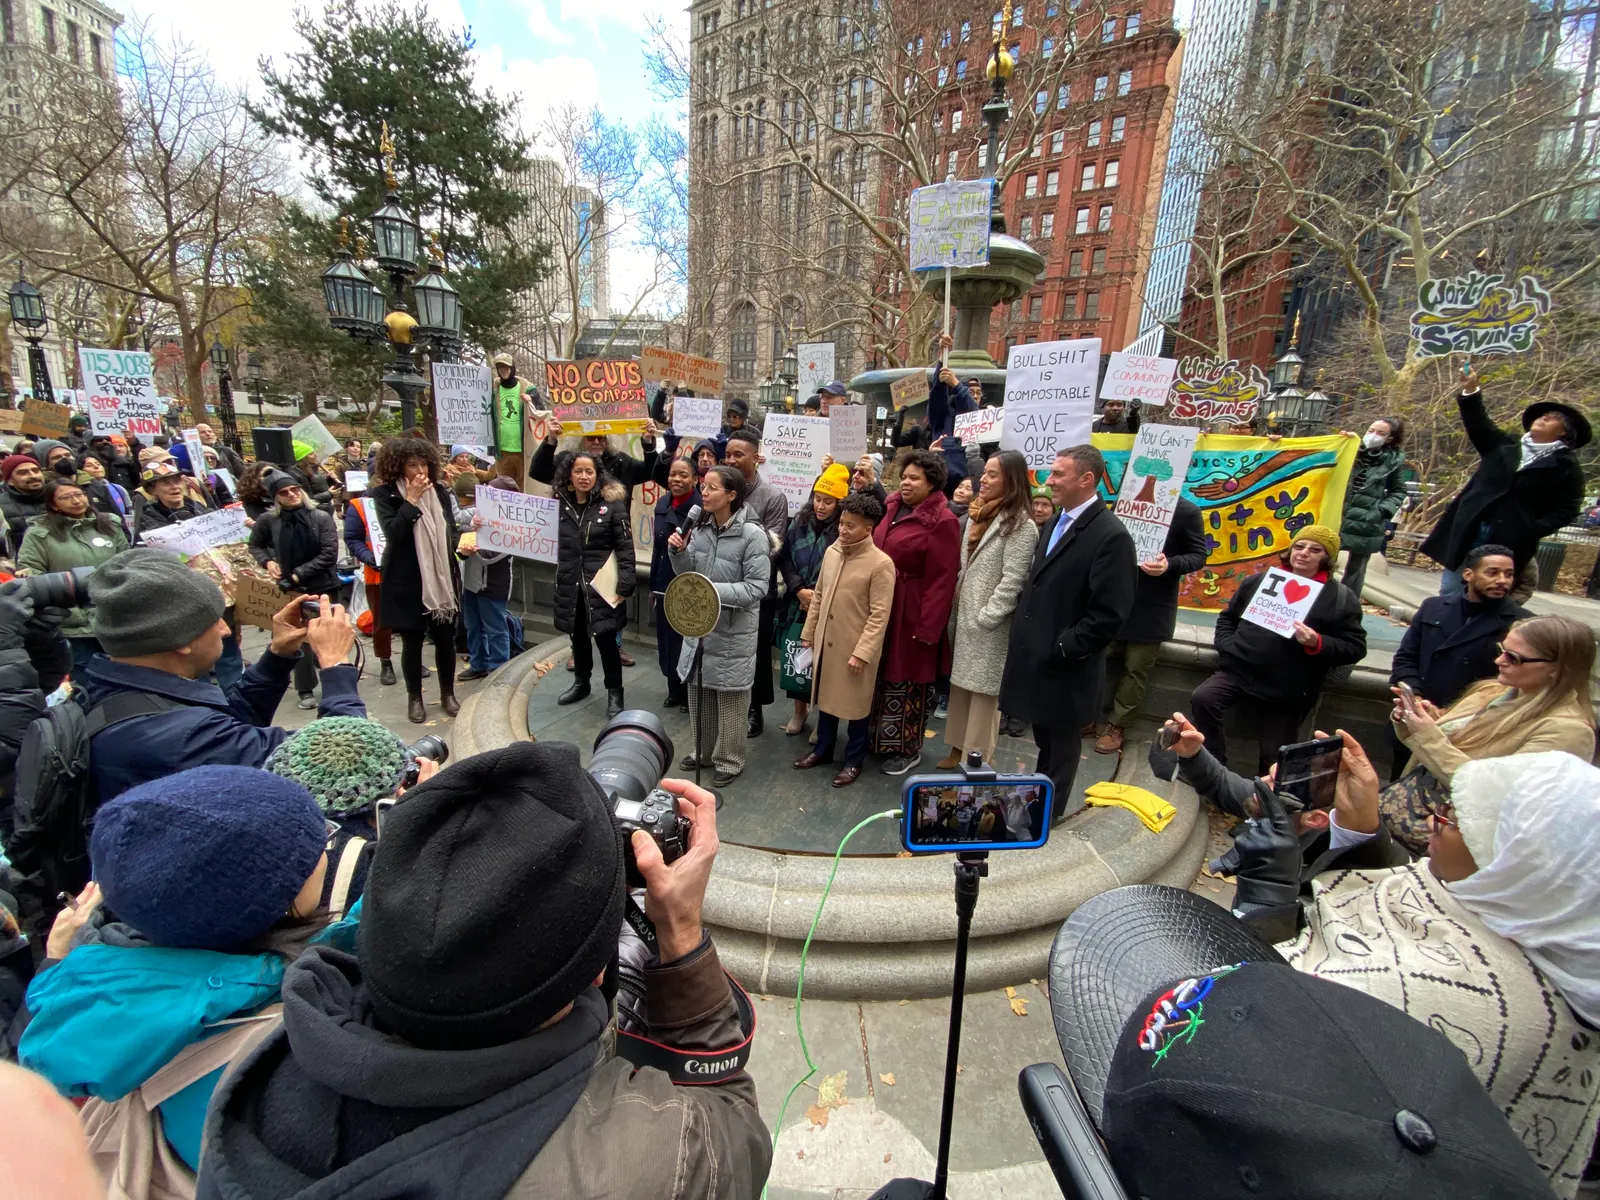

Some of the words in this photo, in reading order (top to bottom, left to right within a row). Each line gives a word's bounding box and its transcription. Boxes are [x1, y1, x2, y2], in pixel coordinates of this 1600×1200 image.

[82, 352, 112, 374] 115
[112, 353, 151, 376] JOBS
[644, 347, 686, 362] COMMUNITY
[686, 357, 718, 372] COMPOST
[1013, 349, 1089, 369] BULLSHIT
[1125, 356, 1159, 372] SAVE
[546, 363, 582, 389] NO
[586, 361, 642, 389] CUTS
[669, 360, 699, 375] BUILDING
[95, 374, 150, 387] DECADES
[648, 366, 654, 375] A
[660, 367, 686, 380] BETTER
[689, 374, 720, 390] FUTURE
[1040, 371, 1053, 382] IS
[1113, 370, 1170, 384] COMMUNITY
[113, 386, 146, 397] WORK
[550, 387, 578, 404] TO
[579, 386, 646, 404] COMPOST!
[1007, 386, 1090, 402] COMPOSTABLE
[1114, 385, 1167, 398] COMPOST
[90, 394, 121, 410] STOP
[124, 398, 156, 410] these
[675, 400, 698, 412] SAVE
[700, 402, 720, 413] OUR
[118, 409, 158, 420] Budget
[955, 411, 978, 428] SAVE
[982, 407, 1004, 422] NYC
[96, 418, 127, 430] cuts
[128, 418, 160, 434] NOW
[954, 422, 994, 436] COMPOST
[1013, 413, 1068, 433] SAVE
[777, 425, 808, 438] SAVE
[1140, 425, 1157, 445] YOU
[1160, 430, 1193, 448] CAN'T
[764, 438, 812, 450] COMMUNITY
[1024, 436, 1058, 452] OUR
[771, 448, 812, 458] COMPOSTING
[1025, 454, 1056, 466] OBS
[1146, 446, 1172, 460] HAVE
[475, 486, 500, 502] THE
[500, 490, 522, 505] BIG
[524, 496, 556, 511] APPLE
[498, 504, 547, 526] NEEDS
[1116, 500, 1173, 523] COMPOST
[487, 520, 542, 537] OMMUNITY
[1122, 518, 1162, 536] ITHOUT
[1261, 572, 1286, 598] I
[1256, 596, 1300, 618] COMPOST
[1264, 618, 1291, 632] compost
[1276, 616, 1288, 624] our
[684, 1056, 738, 1074] Canon
